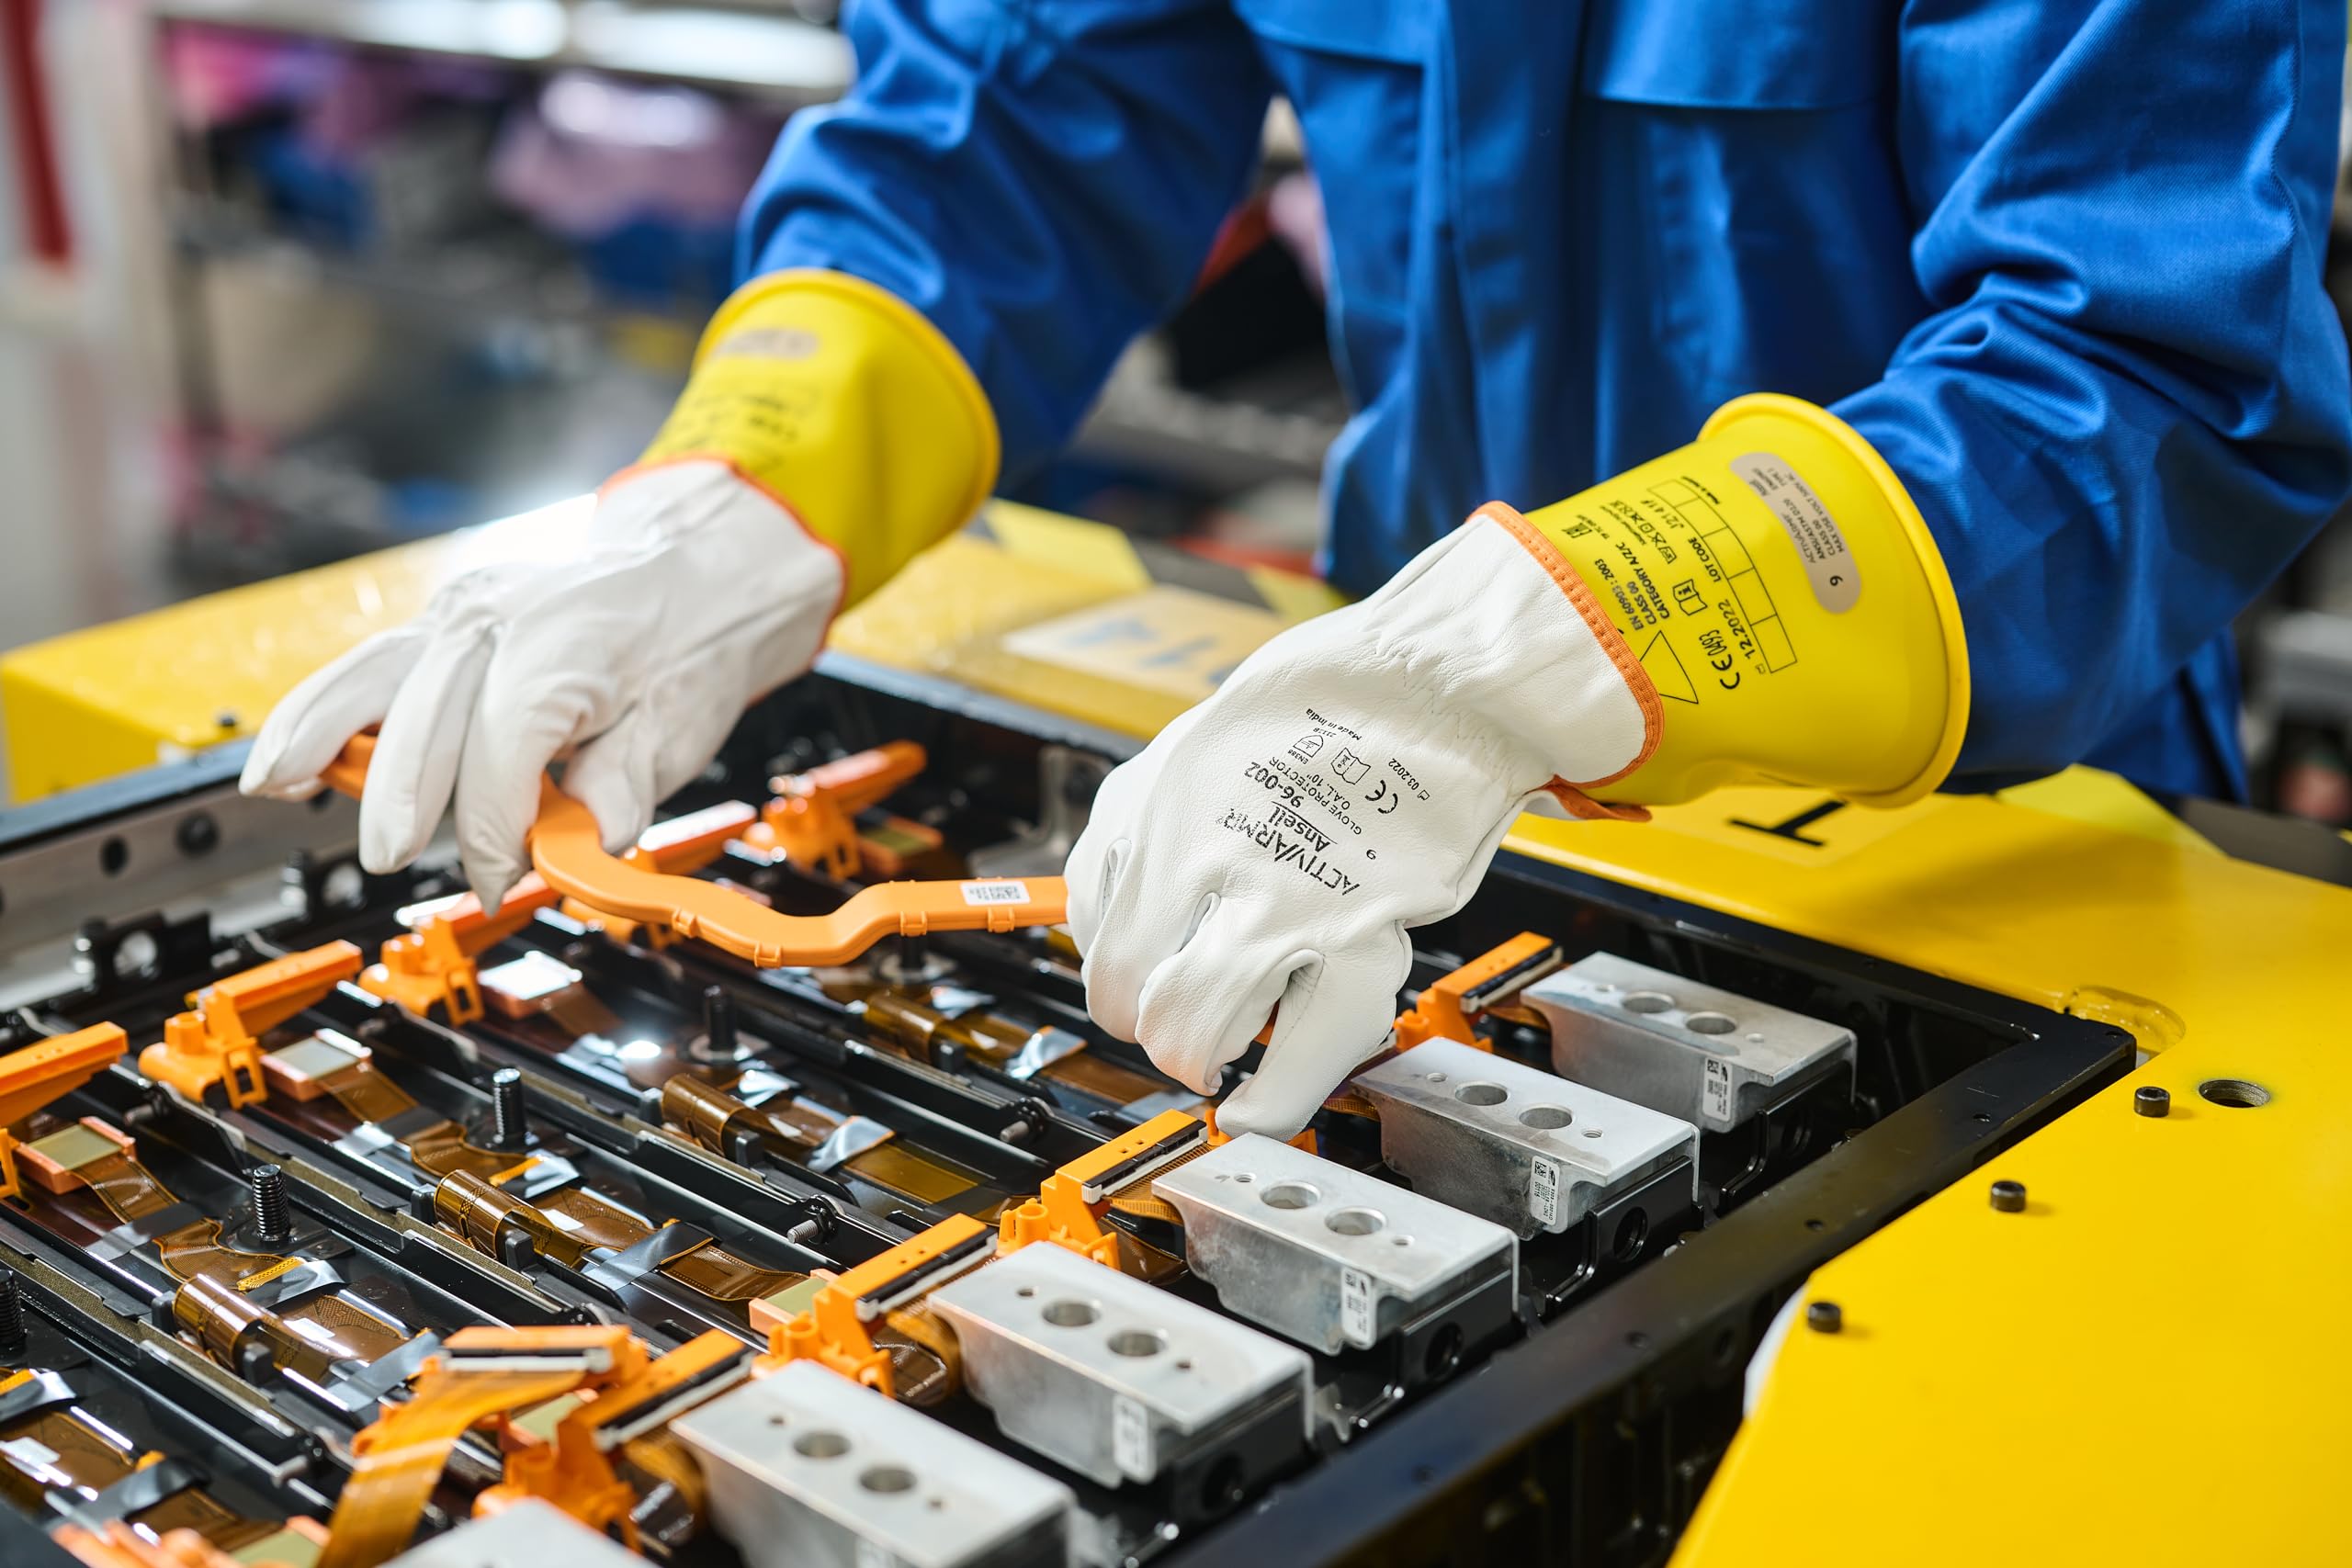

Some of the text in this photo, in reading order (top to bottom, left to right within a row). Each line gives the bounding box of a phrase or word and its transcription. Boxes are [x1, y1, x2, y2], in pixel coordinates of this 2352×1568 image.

[1615, 542, 1639, 565] A/Z/C
[1819, 531, 1836, 556] CLASS
[1595, 558, 1614, 581] 2003
[1689, 537, 1722, 582] LOT CODE
[1634, 568, 1669, 619] CATEGORY
[1830, 576, 1843, 586] 9
[1612, 586, 1634, 615] 60903
[1627, 581, 1657, 625] CLASS 00
[1629, 613, 1644, 630] EN
[1718, 599, 1755, 660] 12.2022
[1306, 709, 1327, 726] India
[1338, 727, 1362, 740] Made
[1244, 762, 1304, 807] 96-002
[1389, 759, 1419, 790] 03.2022
[1270, 757, 1362, 834] GLOVE PROTECTOR
[1268, 807, 1330, 852] Ansell
[1366, 850, 1376, 860] 9
